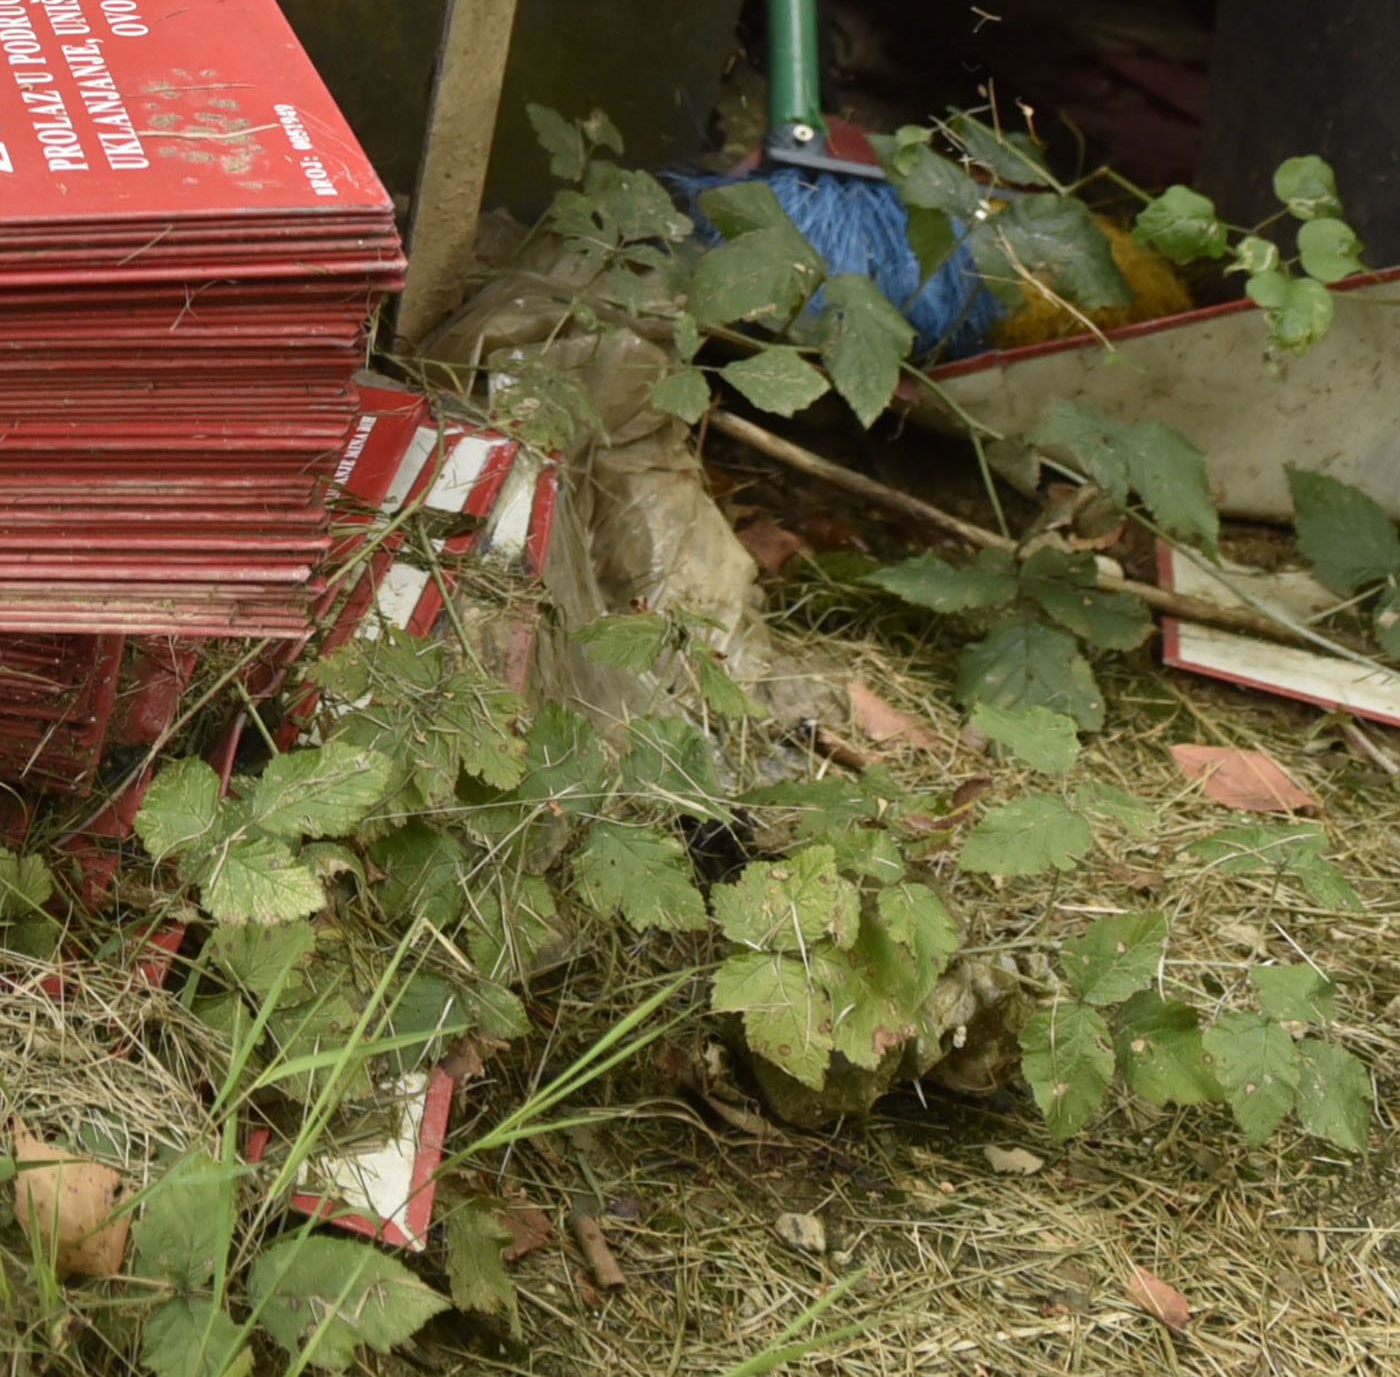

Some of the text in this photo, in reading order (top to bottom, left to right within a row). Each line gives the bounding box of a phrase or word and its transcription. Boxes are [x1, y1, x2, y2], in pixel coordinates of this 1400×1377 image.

[12, 71, 57, 88] U
[58, 38, 150, 169] UKLANJANJE,
[19, 90, 90, 171] PROLAZ
[298, 157, 338, 195] BROJ:
